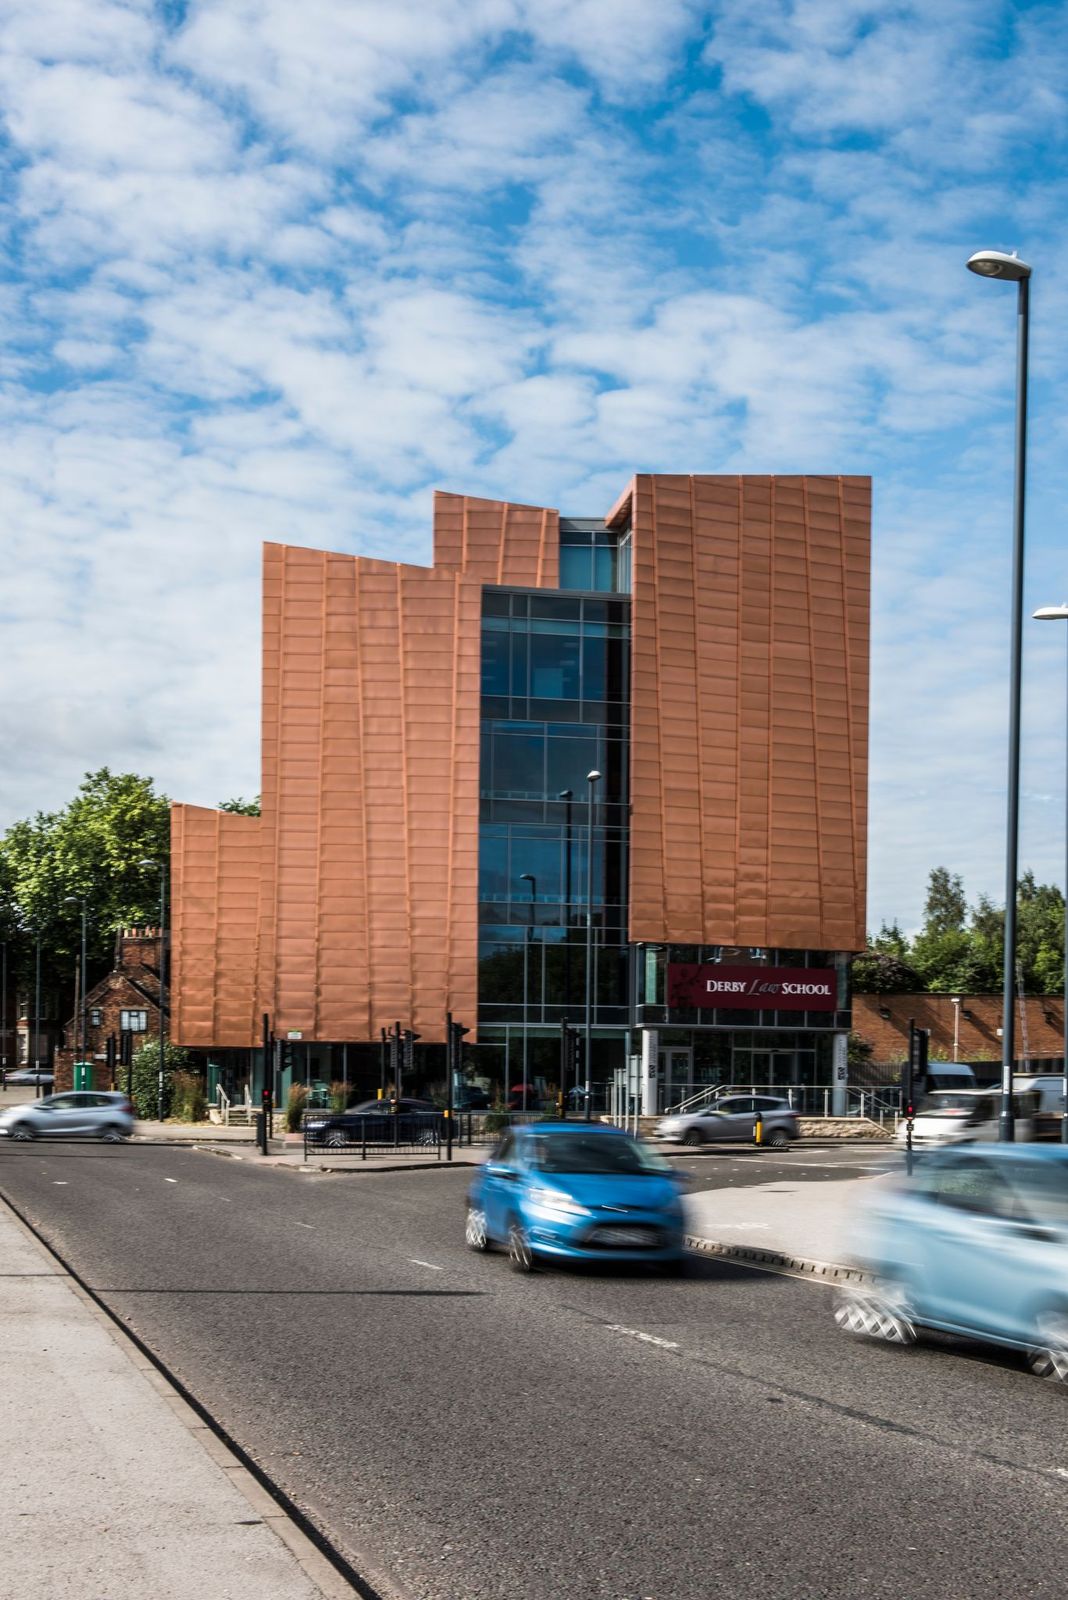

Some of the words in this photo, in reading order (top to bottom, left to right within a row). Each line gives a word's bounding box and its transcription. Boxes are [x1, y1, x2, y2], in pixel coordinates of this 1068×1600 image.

[706, 979, 747, 993] DERBY
[747, 978, 781, 996] Law
[781, 982, 832, 995] SCHOOL
